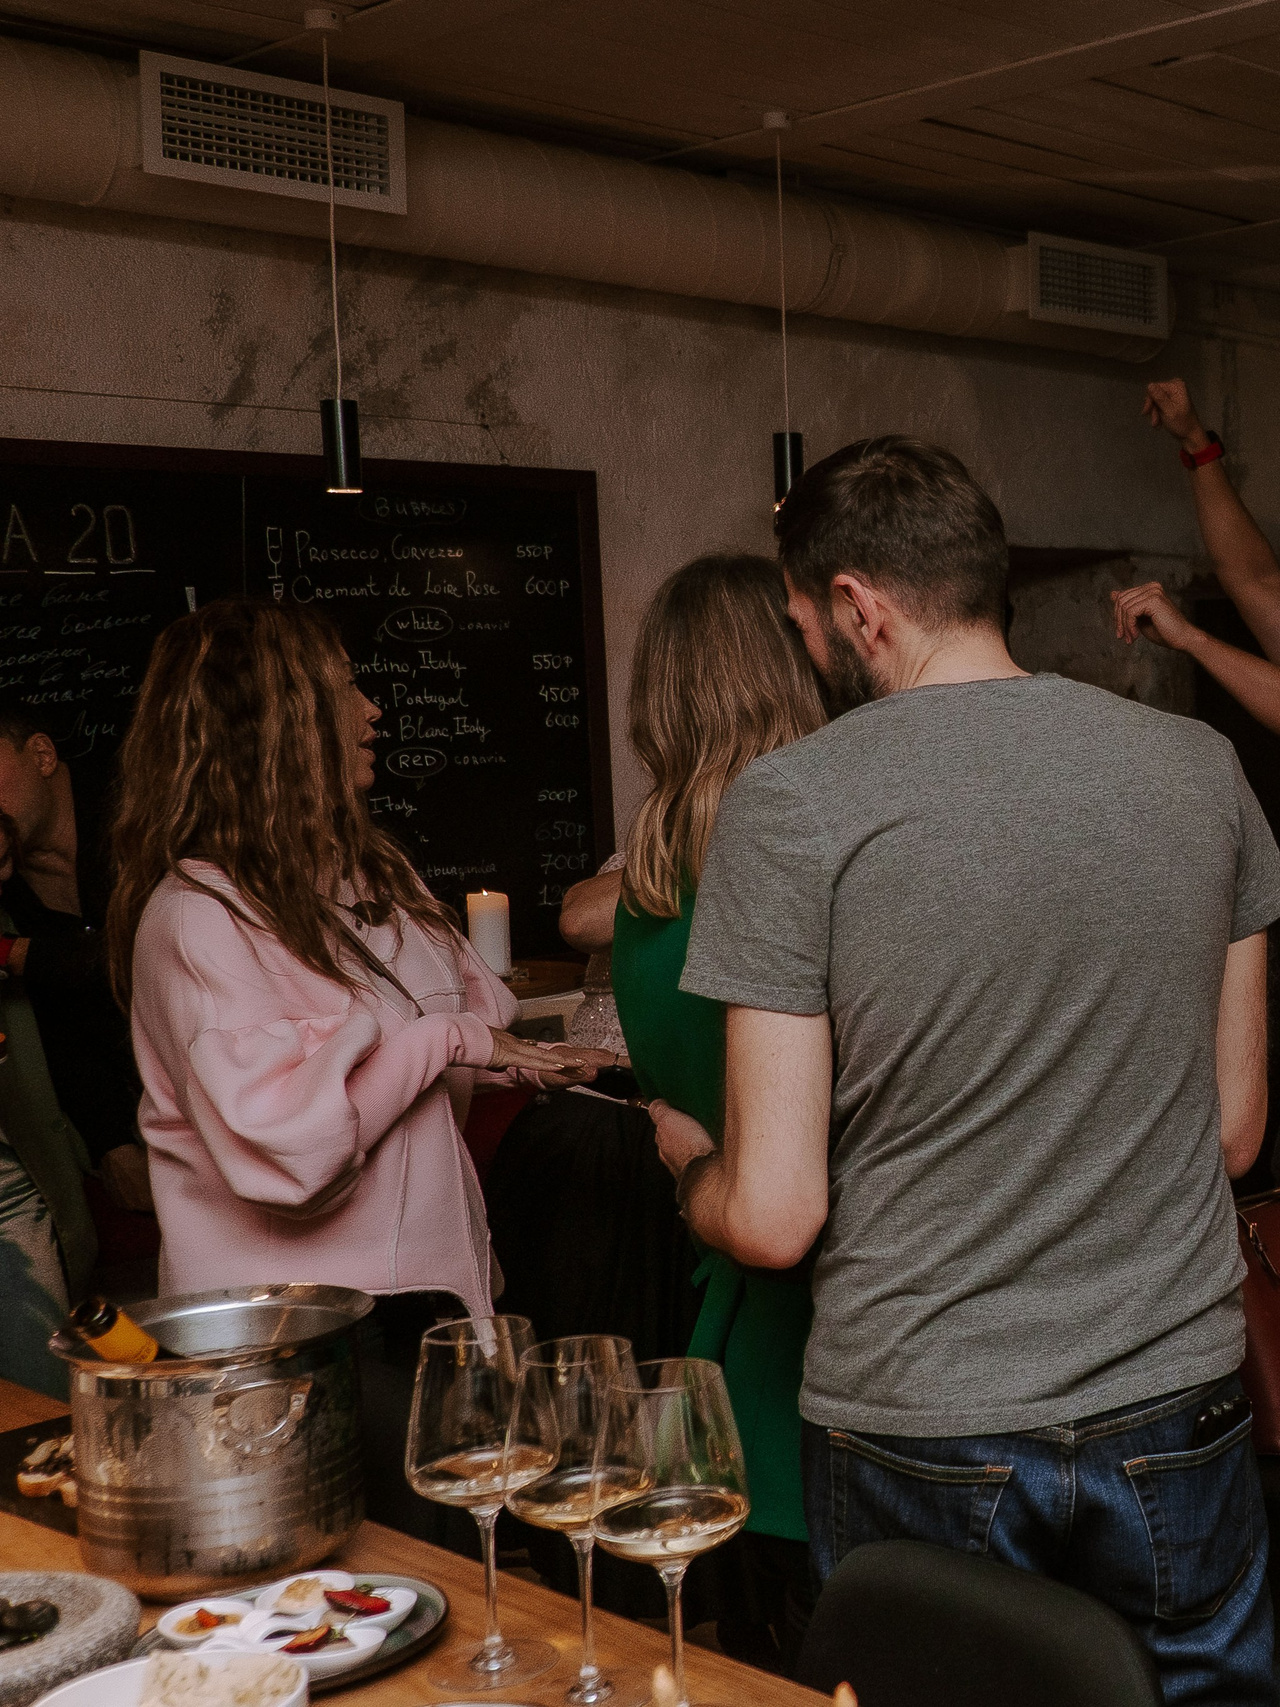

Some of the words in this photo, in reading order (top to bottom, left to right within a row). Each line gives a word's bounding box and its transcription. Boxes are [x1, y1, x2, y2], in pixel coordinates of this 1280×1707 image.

[67, 503, 137, 564] 20
[388, 571, 411, 597] de
[466, 569, 501, 596] Rose
[355, 652, 416, 678] entino,
[418, 649, 467, 679] Italy
[453, 715, 492, 743] Italy
